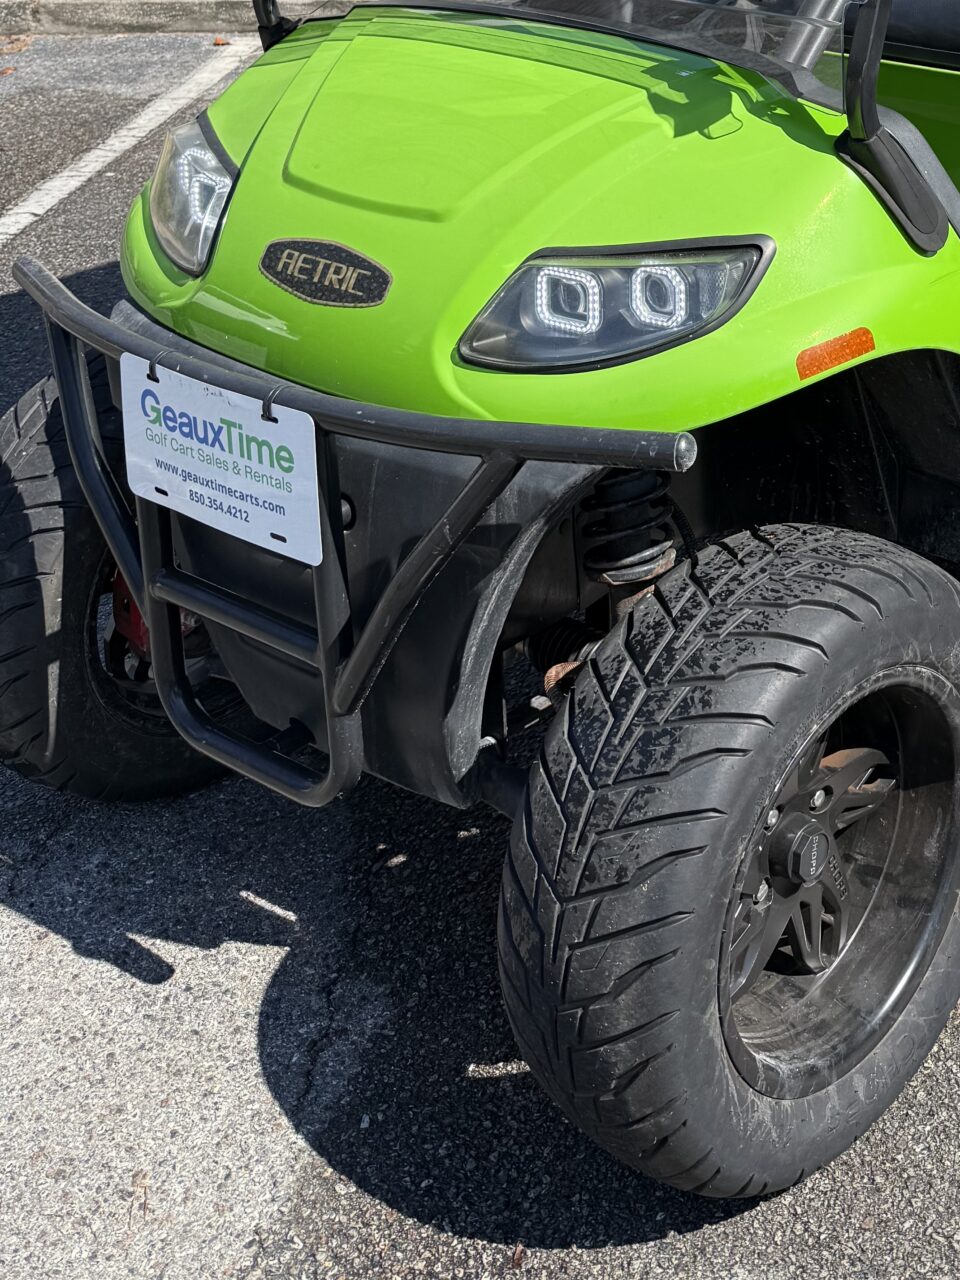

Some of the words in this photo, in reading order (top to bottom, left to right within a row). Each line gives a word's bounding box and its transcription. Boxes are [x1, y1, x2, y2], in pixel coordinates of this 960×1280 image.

[140, 388, 295, 474] GeauxTime
[145, 427, 168, 447] Golf
[170, 437, 195, 459] Cart
[197, 448, 229, 472] Sales
[232, 460, 242, 475] &
[245, 465, 293, 493] Rentals
[155, 458, 286, 516] www.geauxtimecarts.com
[188, 489, 251, 523] 850.354.4212
